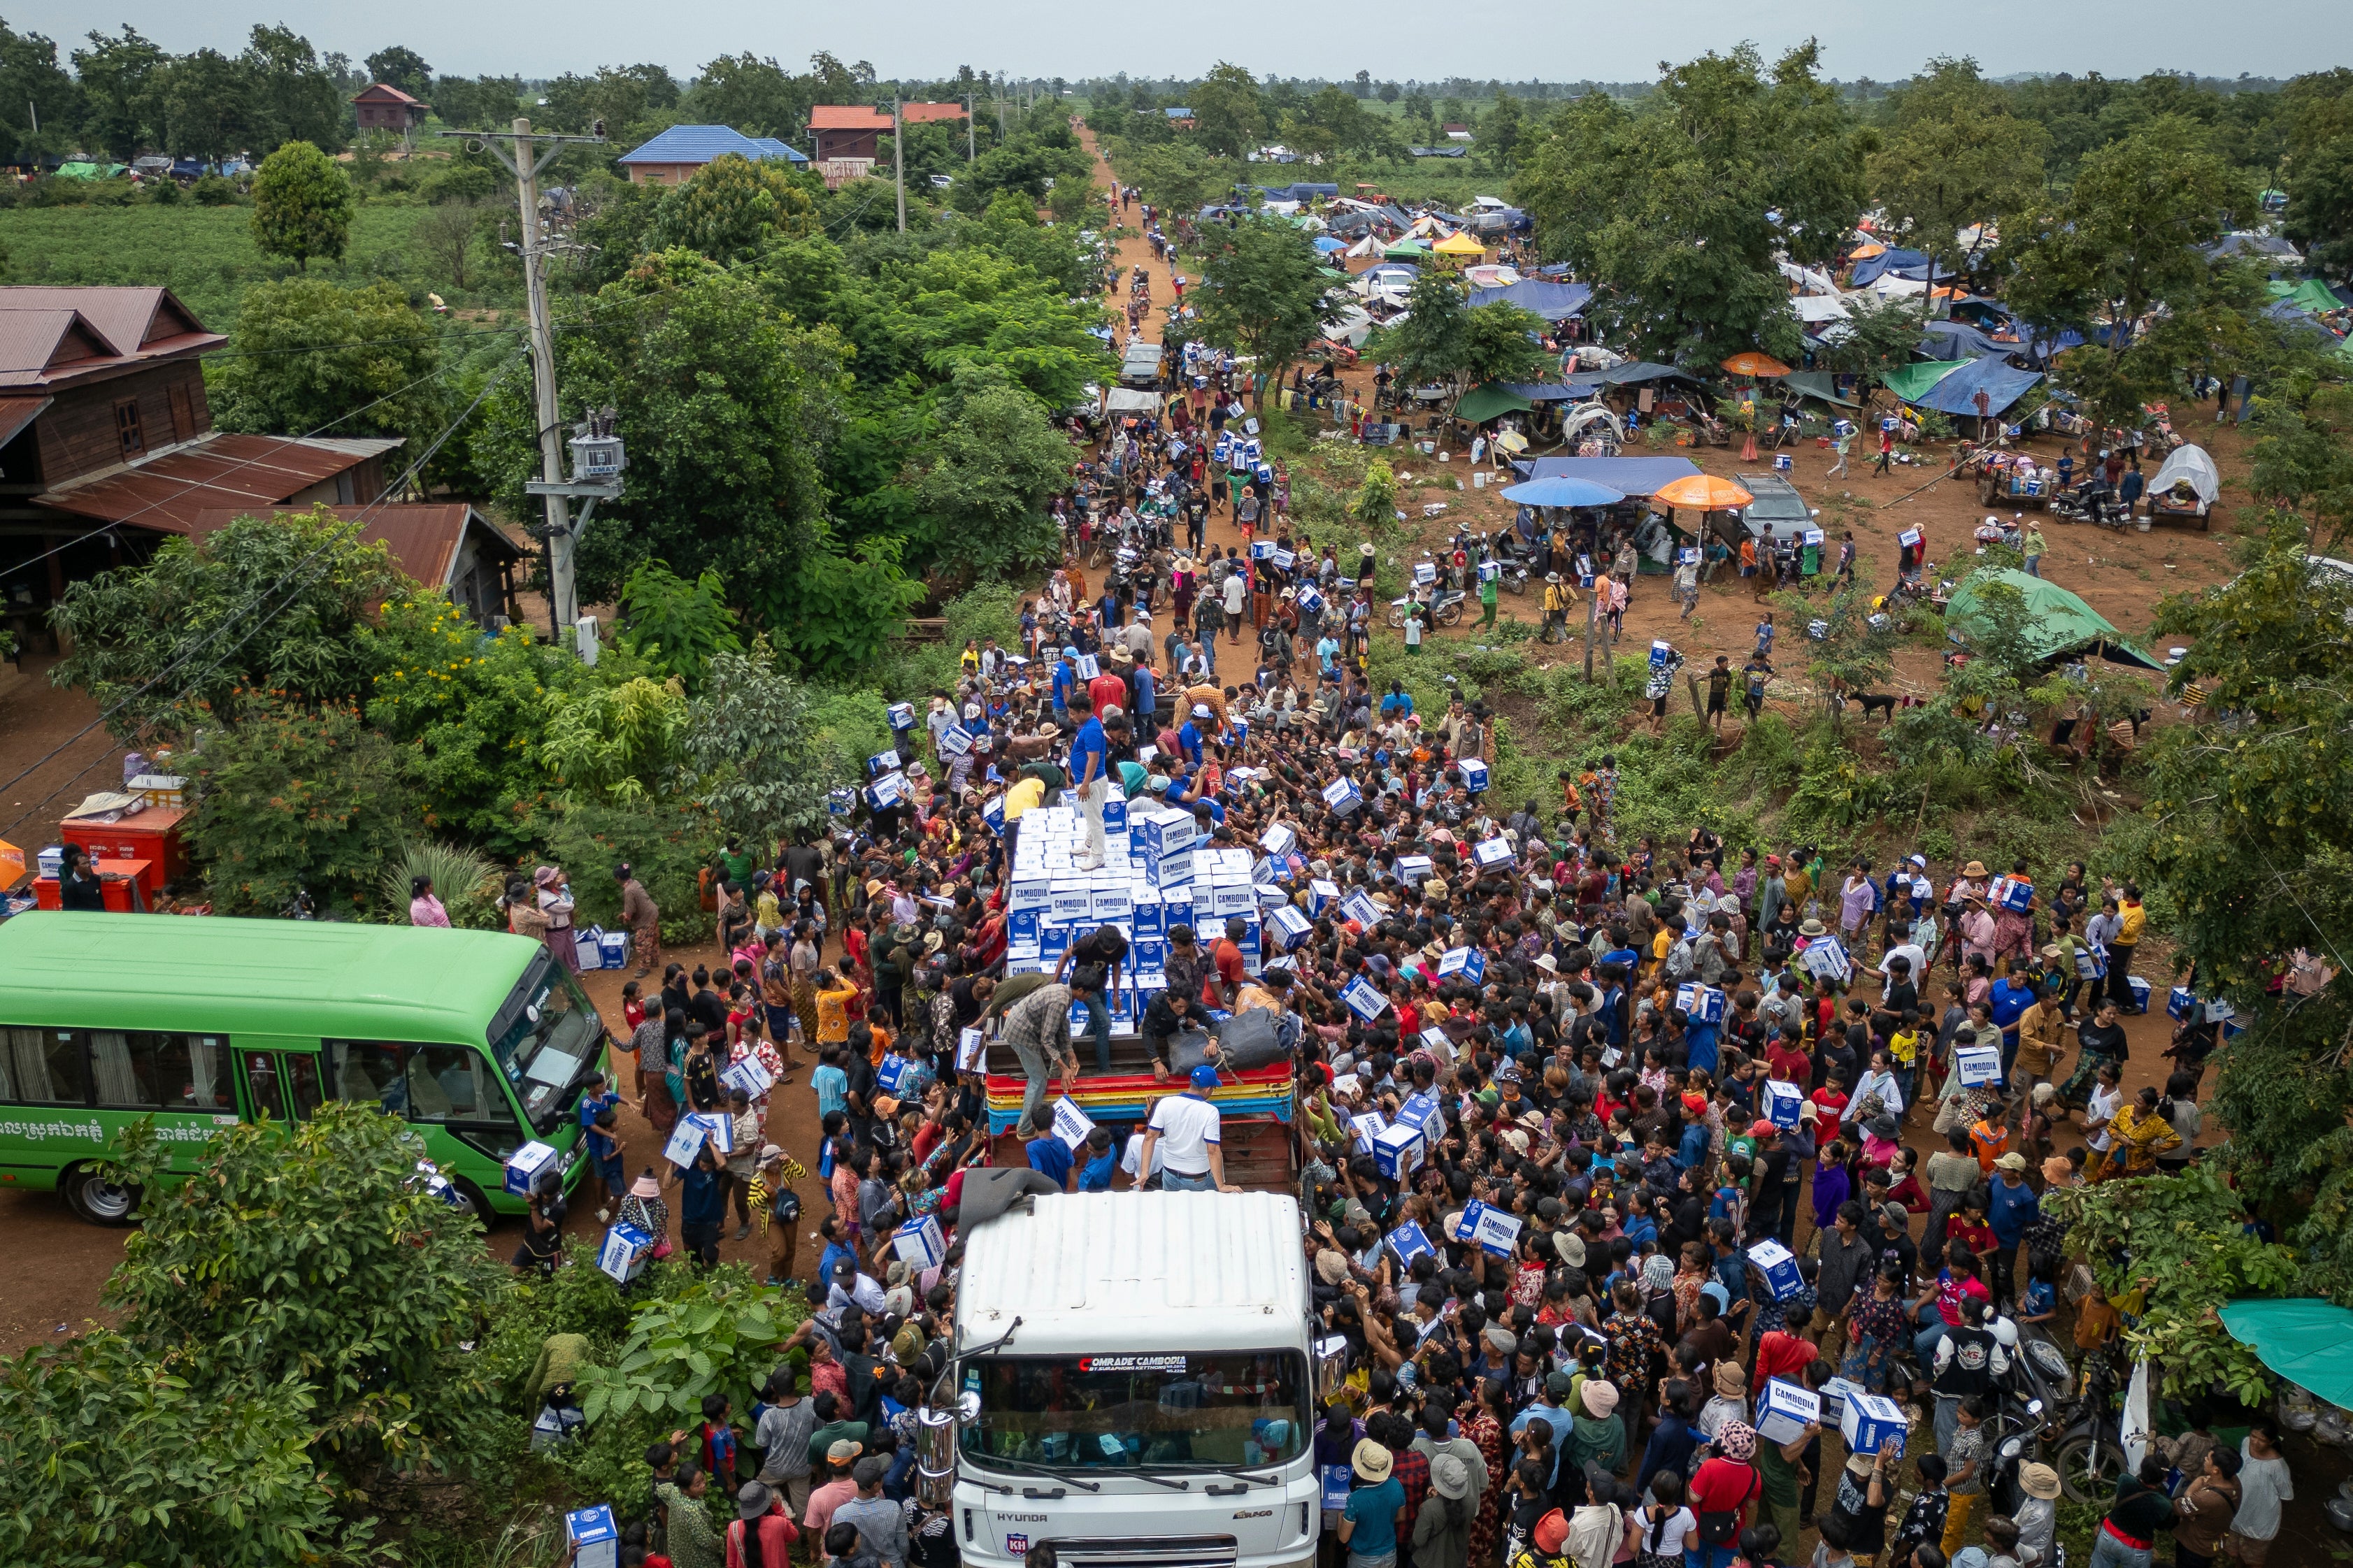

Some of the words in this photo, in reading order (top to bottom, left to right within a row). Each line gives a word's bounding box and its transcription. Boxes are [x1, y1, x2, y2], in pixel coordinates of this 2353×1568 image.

[1166, 826, 1193, 842] CAMBODIA
[1163, 859, 1192, 875] CAMBODIA
[1016, 889, 1047, 898] CAMBODIA
[1193, 895, 1209, 904] ODIA
[1217, 893, 1250, 903] CAMBODIA
[1054, 899, 1087, 909] CAMBODIA
[1096, 898, 1128, 907] CAMBODIA
[1285, 909, 1303, 930] CAMBODIA
[1352, 900, 1373, 924] CAMBODIA
[1243, 959, 1257, 968] ODIA
[1356, 988, 1380, 1012] CAMBODIA
[1964, 1061, 1997, 1072] CAMBODIA
[732, 1070, 754, 1097] CAMBODIA
[820, 1079, 836, 1100] 10
[1055, 1105, 1084, 1139] CAMBODIA
[1365, 1116, 1380, 1137] CAMBO
[1482, 1216, 1514, 1239] CAMBODIA
[929, 1223, 945, 1259] CAMBODIA
[610, 1242, 627, 1274] CAMBODIA
[1079, 1356, 1136, 1372] COMRADE
[1137, 1355, 1187, 1366] CAMBODIA
[1966, 1351, 1979, 1360] KS
[1775, 1387, 1815, 1411] CAMBODIA
[579, 1526, 608, 1539] CAMBODIA
[1010, 1540, 1026, 1551] KH
